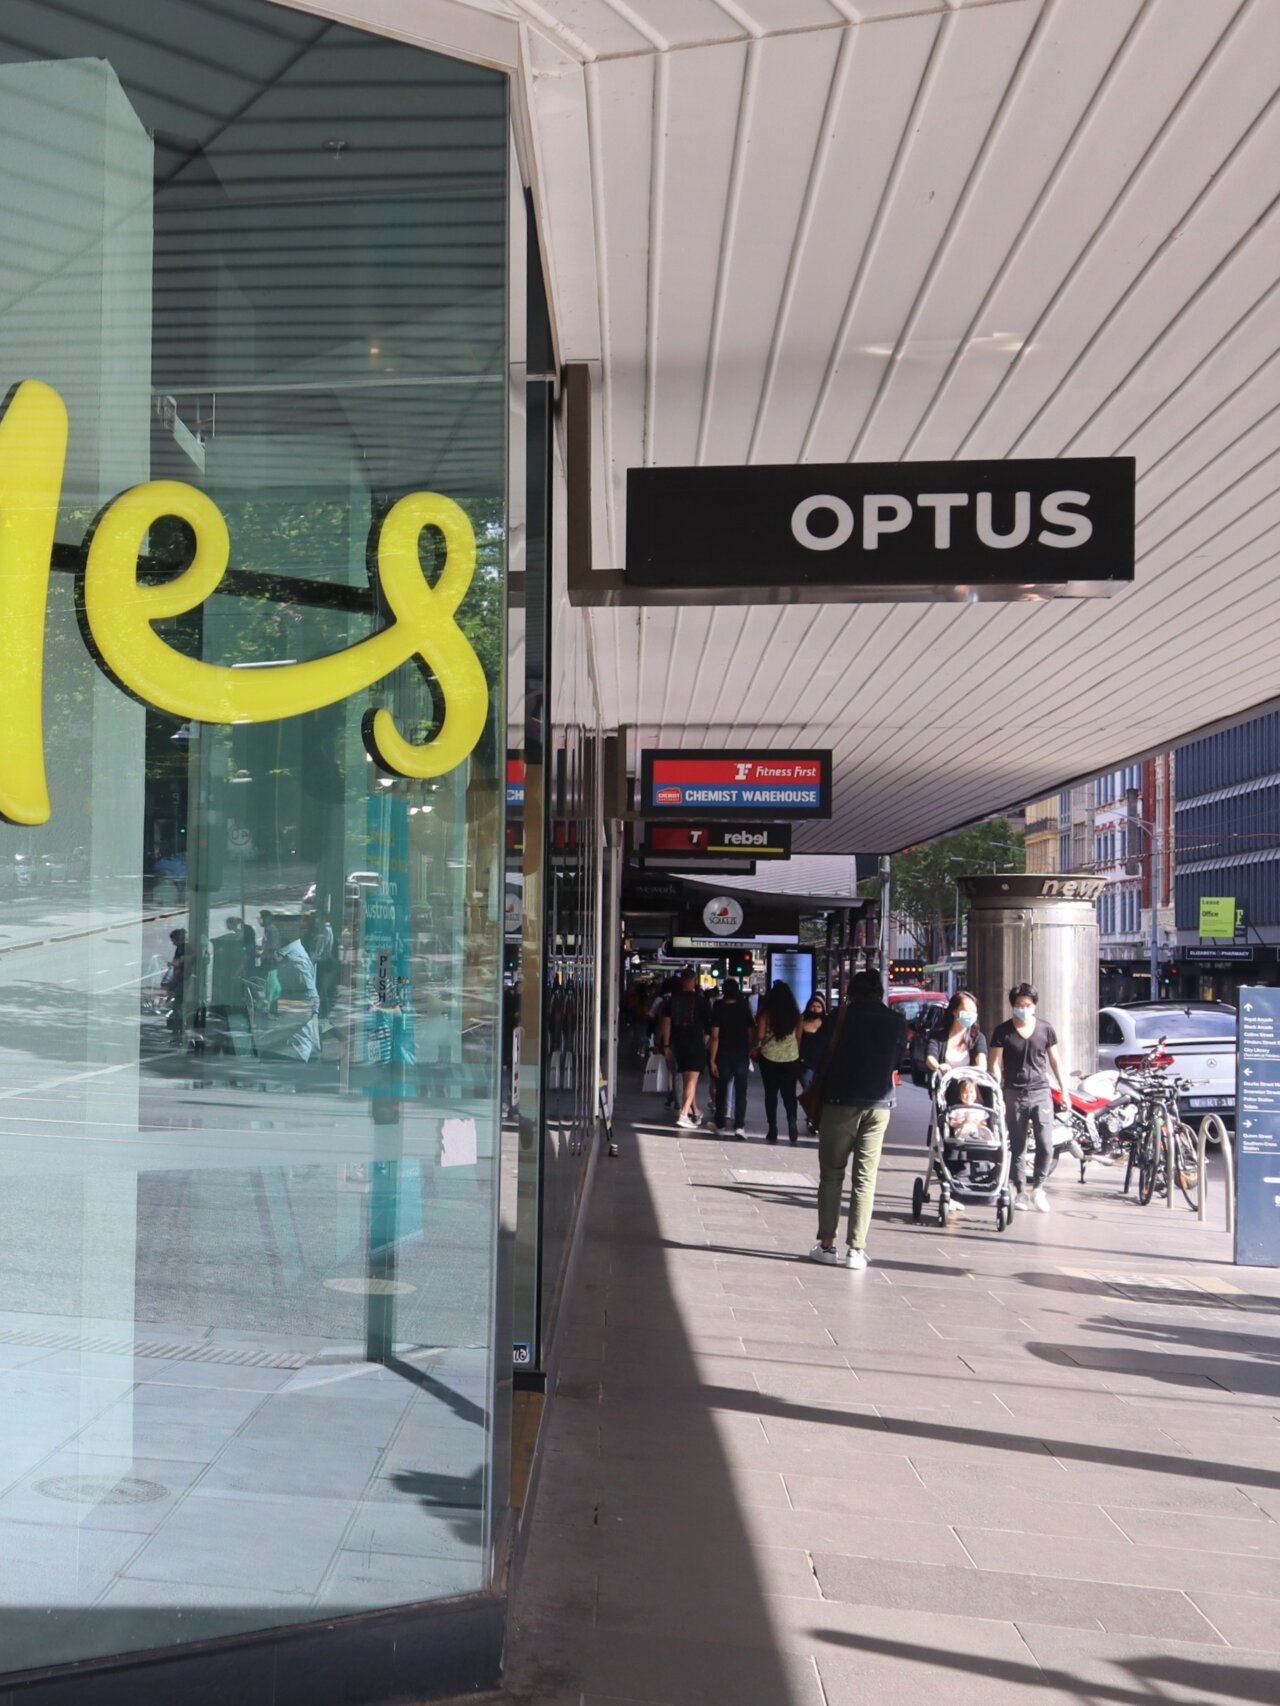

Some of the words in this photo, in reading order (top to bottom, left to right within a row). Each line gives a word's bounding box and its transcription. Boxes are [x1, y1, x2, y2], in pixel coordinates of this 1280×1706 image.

[790, 490, 1094, 552] OPTUS
[685, 790, 738, 802] CHEMIST
[742, 790, 817, 802] WAREHOUSE
[724, 830, 768, 845] rebel
[378, 955, 388, 1003] PUSH
